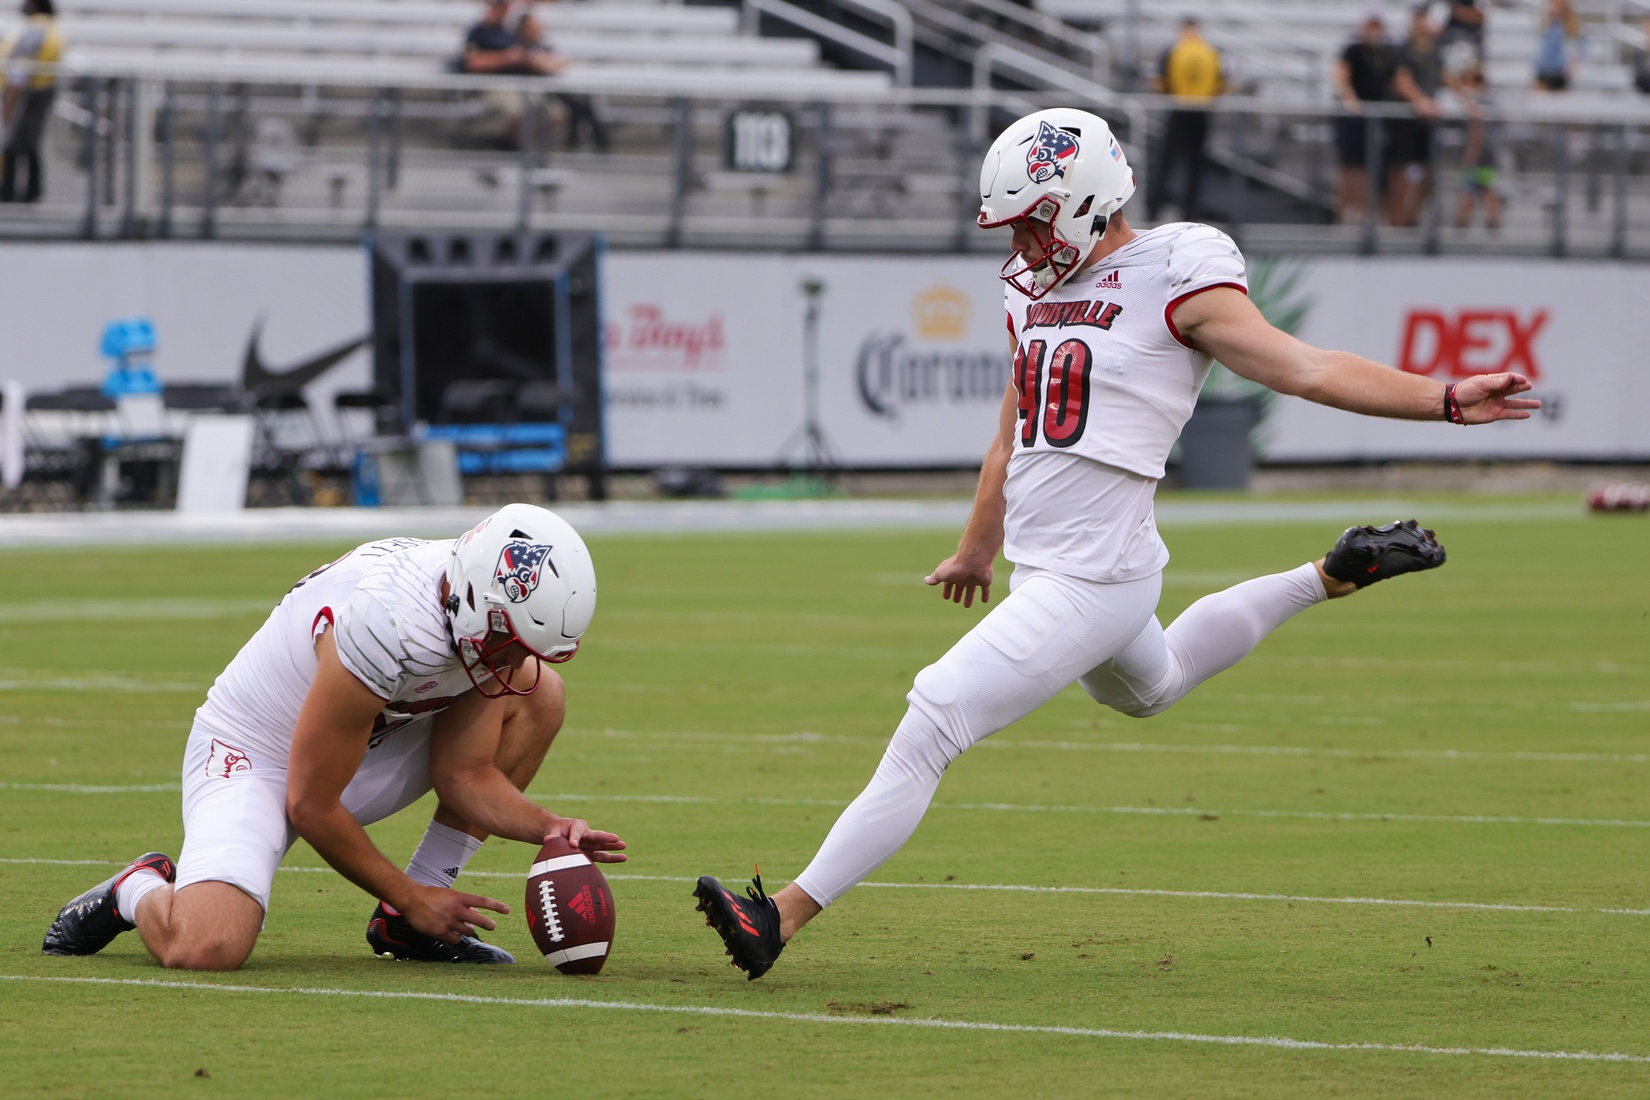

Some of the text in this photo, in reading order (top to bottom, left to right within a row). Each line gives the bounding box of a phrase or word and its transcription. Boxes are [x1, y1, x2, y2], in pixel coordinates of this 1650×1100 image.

[1096, 279, 1122, 290] adidas
[1022, 300, 1123, 333] LOUISVILLE
[1399, 308, 1547, 380] DEX
[1014, 338, 1093, 448] 40
[583, 885, 596, 923] adidas
